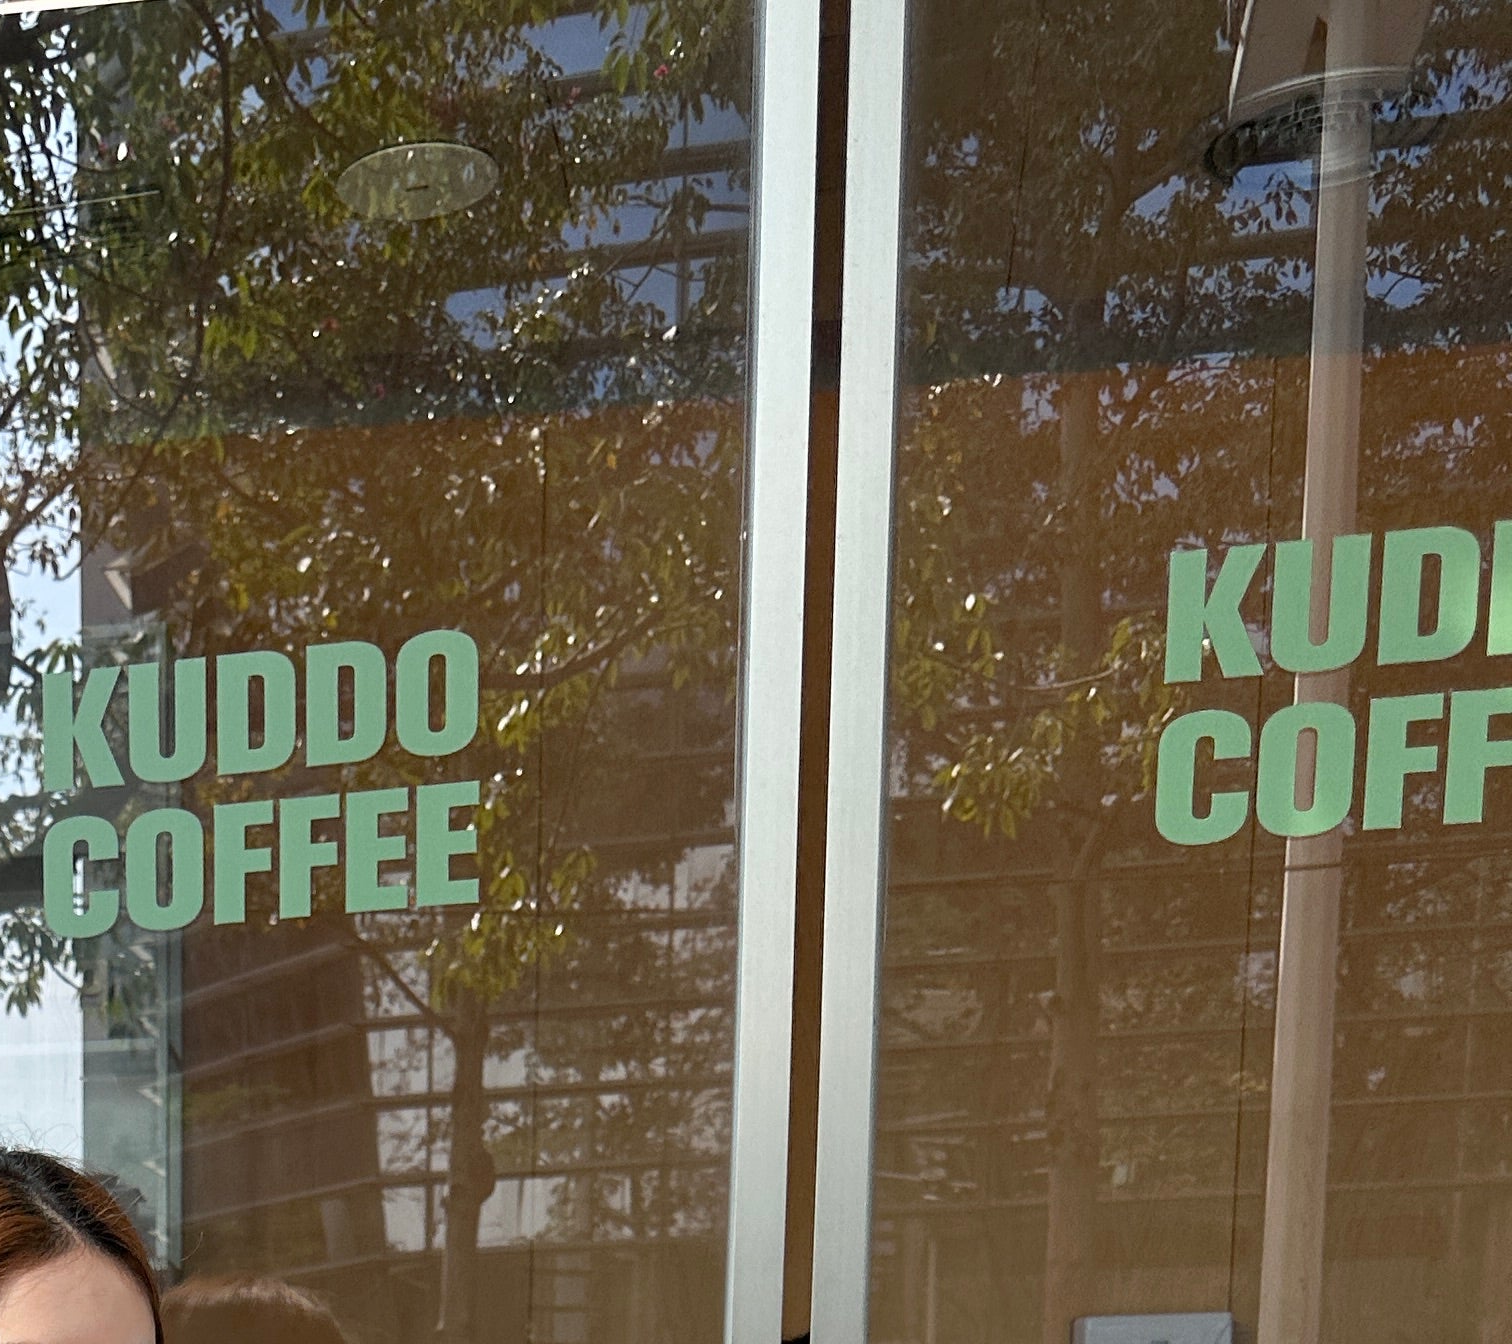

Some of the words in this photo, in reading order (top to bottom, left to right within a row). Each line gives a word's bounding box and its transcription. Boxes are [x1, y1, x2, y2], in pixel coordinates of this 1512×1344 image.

[1164, 520, 1512, 684] KUD
[42, 629, 479, 793] KUDDO
[1155, 687, 1512, 846] COFF
[43, 780, 480, 938] COFFEE
